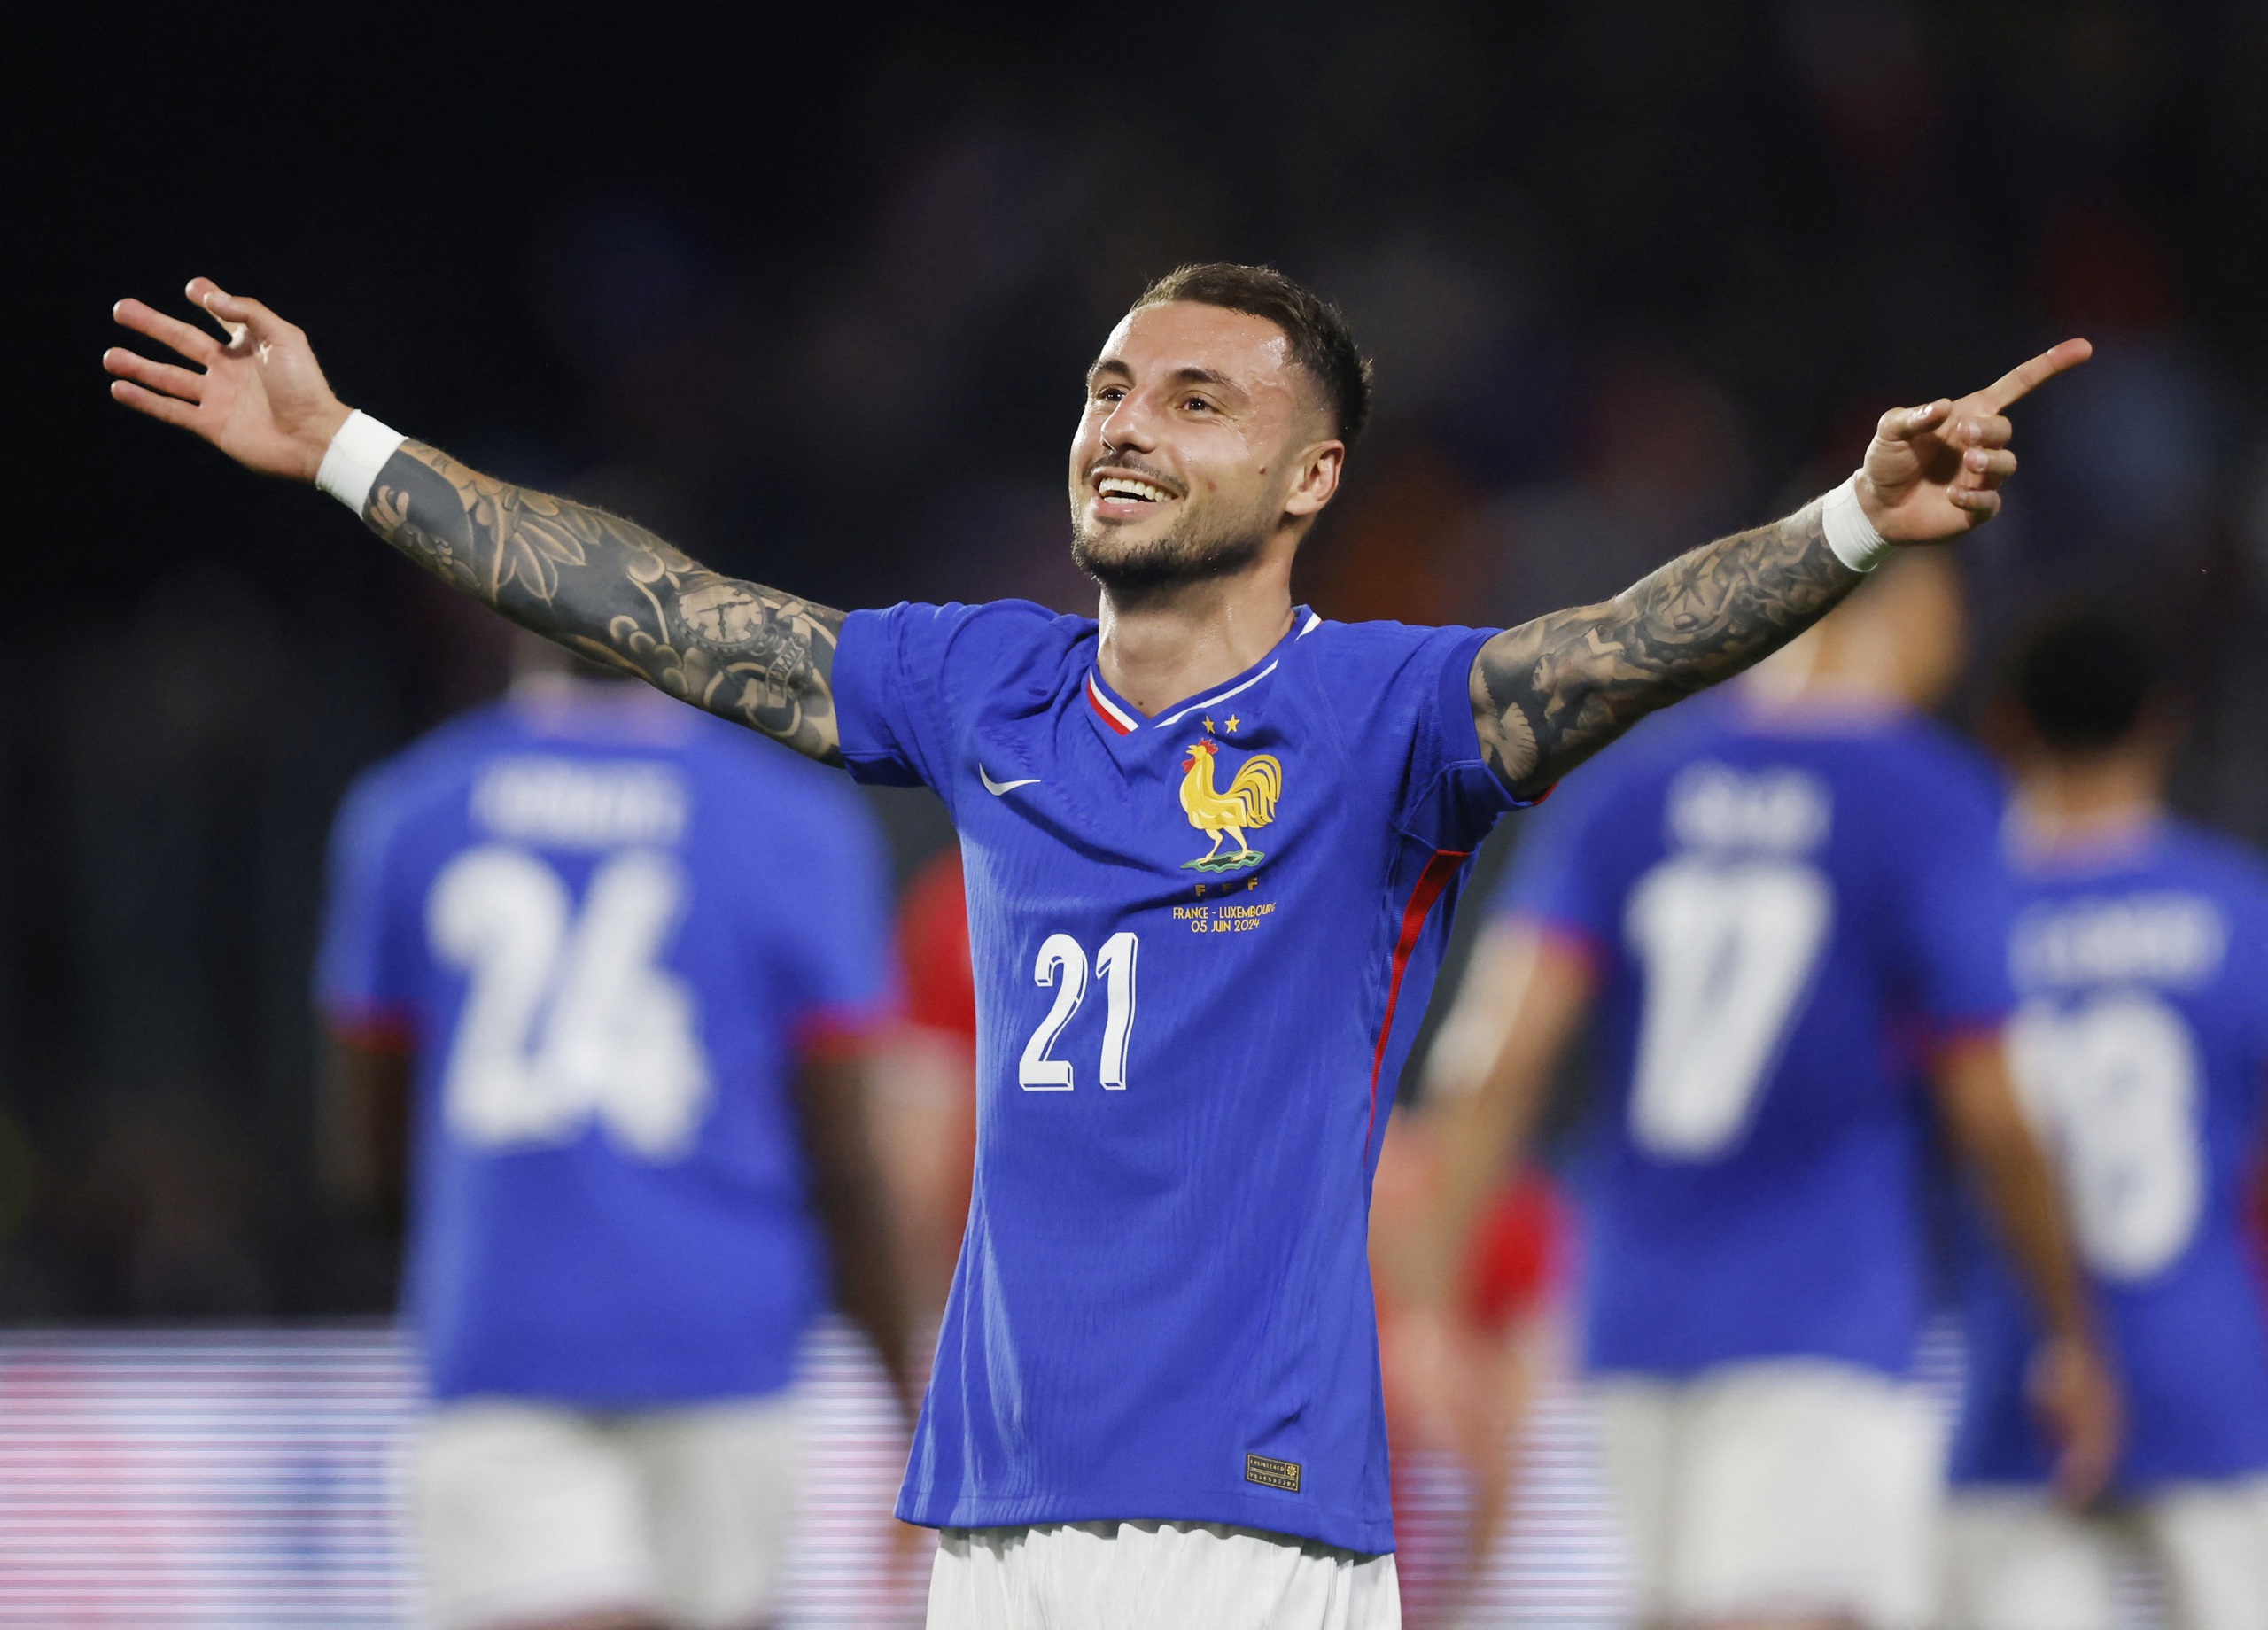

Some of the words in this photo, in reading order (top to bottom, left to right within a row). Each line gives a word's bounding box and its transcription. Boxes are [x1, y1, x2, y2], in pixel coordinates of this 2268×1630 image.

[1173, 907, 1208, 919] FRANCE
[1191, 920, 1208, 933] 05
[1211, 920, 1231, 933] JUIN
[1234, 918, 1260, 932] 2024
[430, 846, 711, 1159] 24
[1019, 932, 1139, 1091] 21
